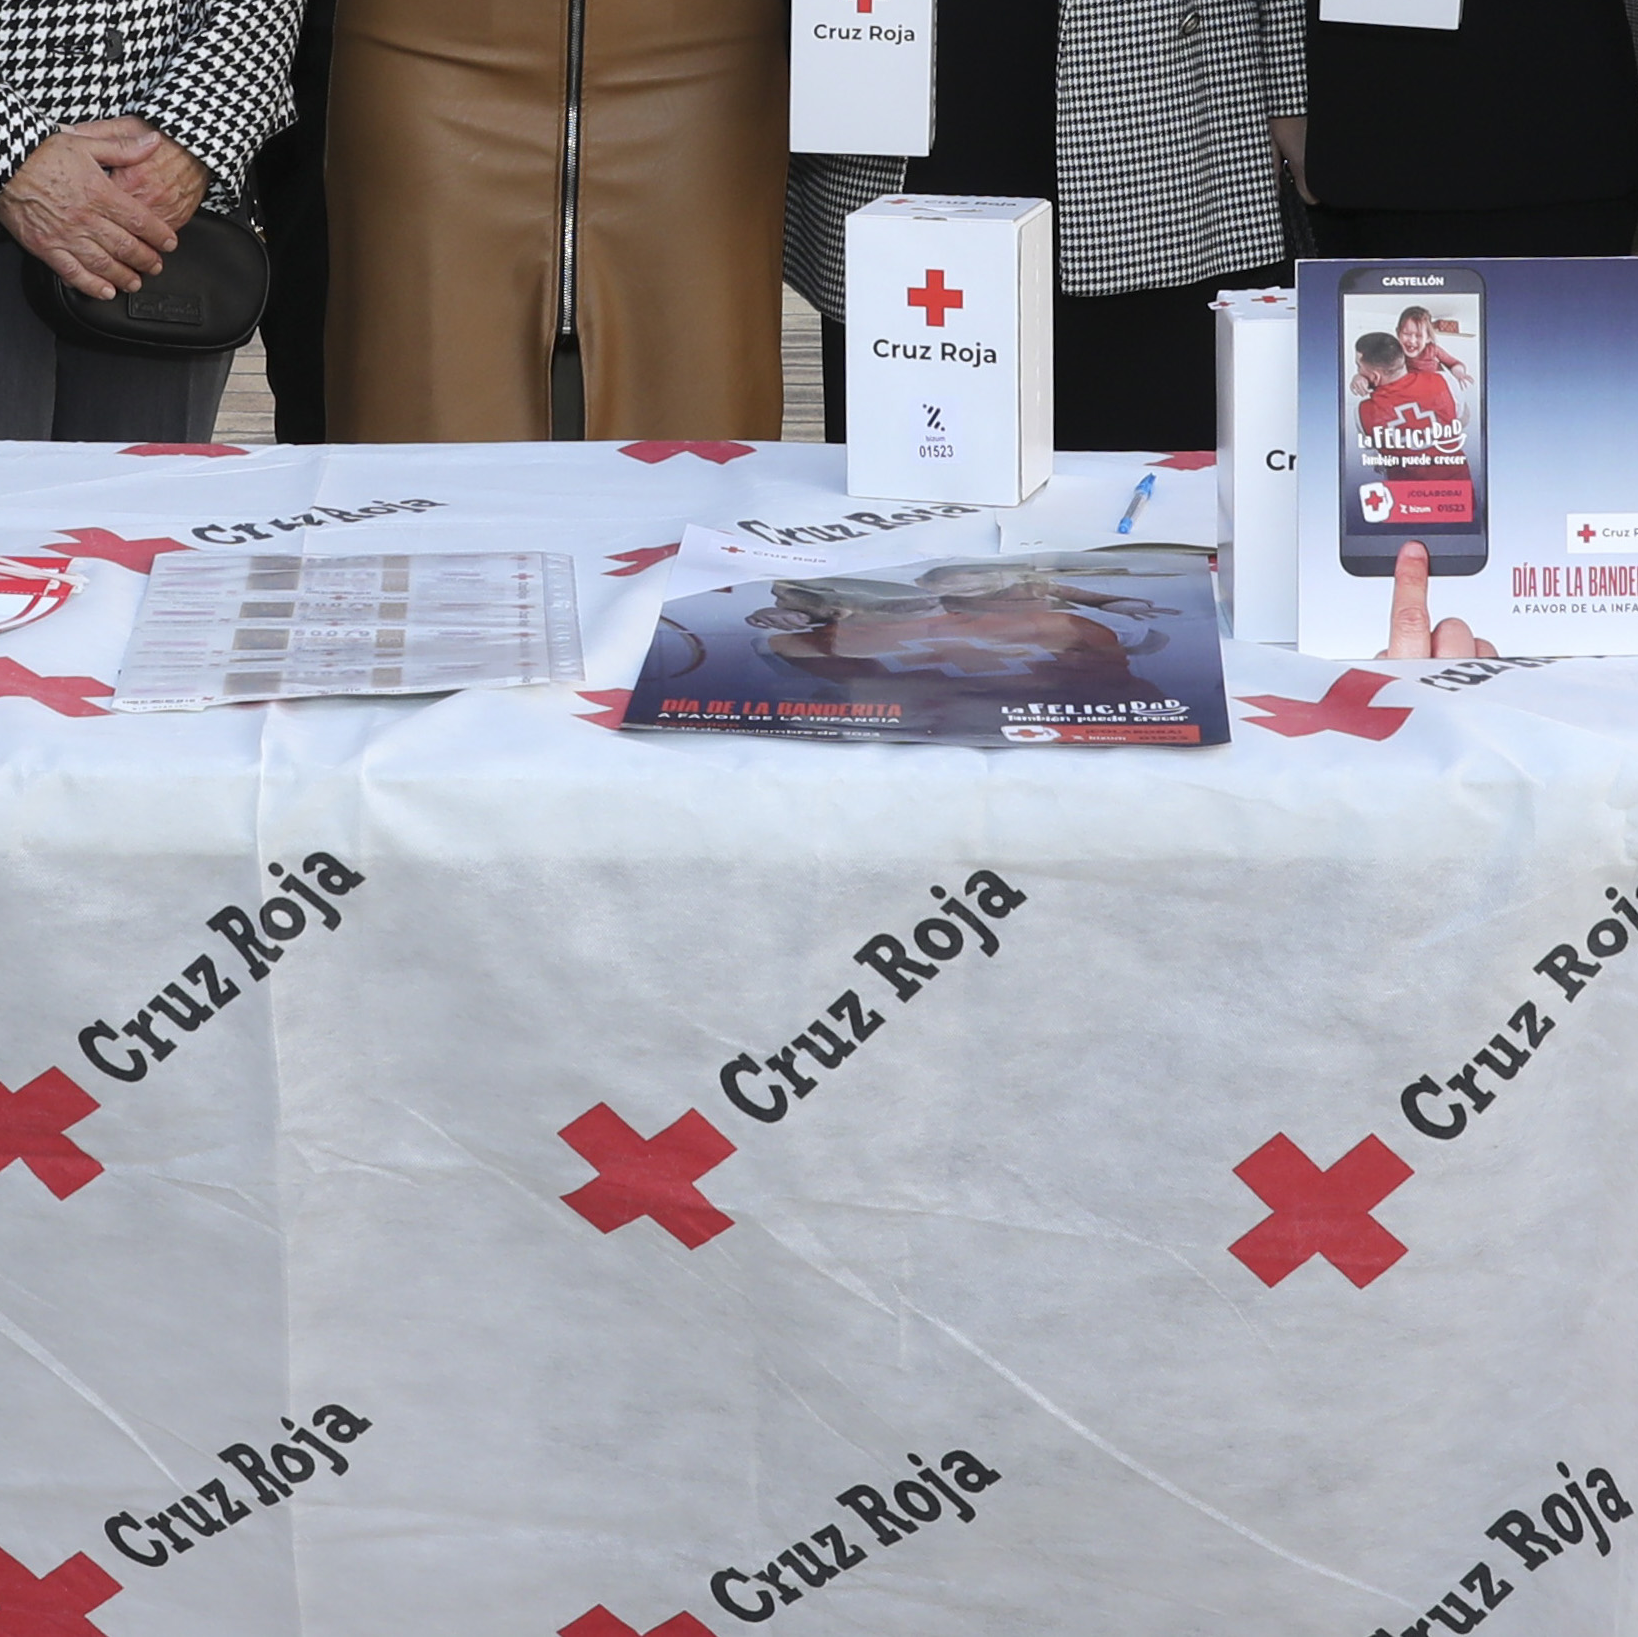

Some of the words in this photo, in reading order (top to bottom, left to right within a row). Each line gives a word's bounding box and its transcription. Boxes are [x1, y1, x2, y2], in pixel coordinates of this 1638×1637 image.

[813, 24, 862, 40] Cruz
[869, 24, 915, 45] Roja
[1382, 276, 1444, 287] CASTELLÓN
[872, 339, 932, 360] Cruz
[940, 342, 997, 368] Roja
[919, 445, 954, 458] 01523
[1402, 453, 1431, 467] puede
[1434, 454, 1467, 466] crecer
[1407, 489, 1462, 498] ¡COLABORA!
[1409, 504, 1432, 513] bizum
[1437, 503, 1465, 513] 01523
[736, 519, 872, 546] Cruz
[1602, 528, 1630, 537] Cruz
[753, 550, 787, 558] Cruz
[1512, 562, 1537, 597] DÍA
[1543, 566, 1561, 597] DE
[1566, 566, 1583, 597] LA
[1512, 604, 1521, 613] A
[1525, 603, 1567, 613] FAVOR
[1571, 603, 1587, 613] DE
[1592, 603, 1607, 613] LA
[661, 697, 700, 713] DÍA
[706, 700, 736, 714] DE
[742, 701, 770, 715] LA
[776, 701, 903, 717] BANDERITA
[677, 713, 741, 721] FAVOR
[809, 716, 900, 724] INFANCIA
[1077, 714, 1127, 722] puede
[1133, 714, 1189, 722] crecer
[76, 954, 240, 1085] Cruz
[206, 844, 367, 983] Roja
[718, 989, 886, 1125] Cruz
[853, 867, 1028, 1003] Roja
[1399, 999, 1557, 1143] Cruz
[102, 1482, 251, 1572] Cruz
[216, 1393, 372, 1507] Roja
[1484, 1460, 1634, 1572] Roja
[709, 1523, 868, 1624] Cruz
[835, 1447, 1003, 1548] Roja
